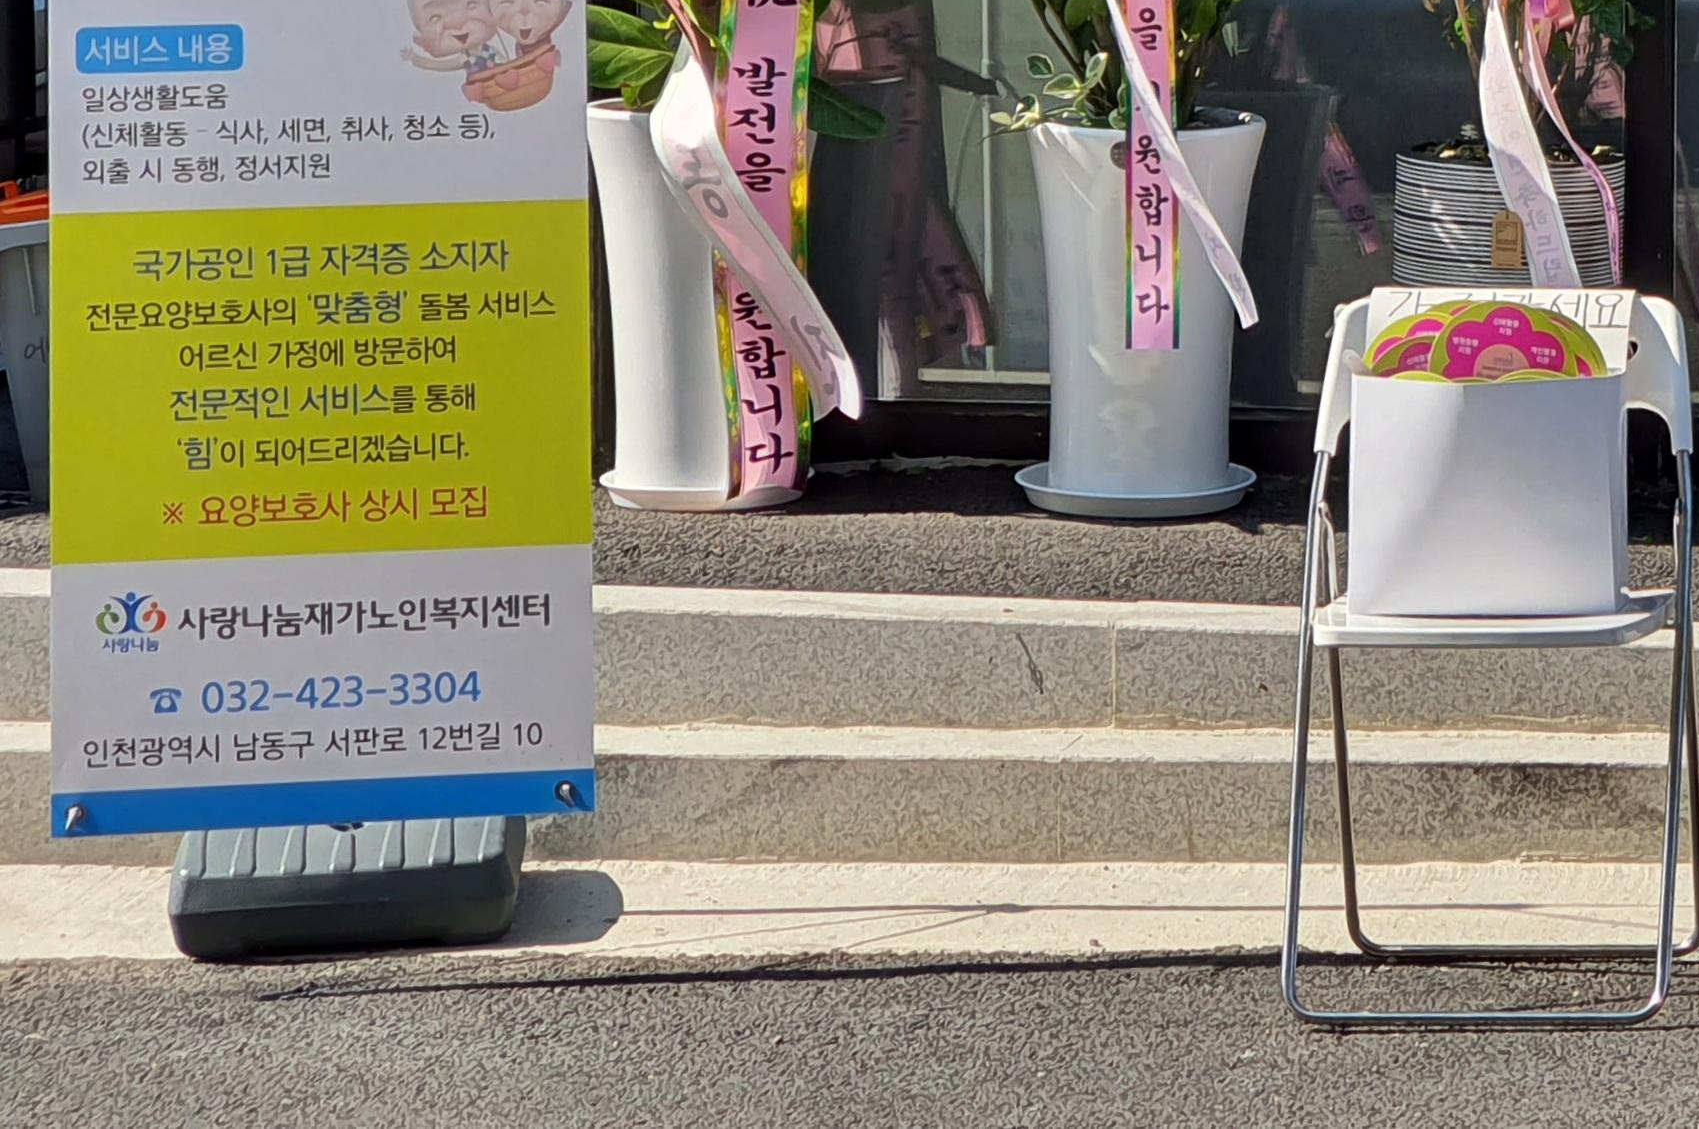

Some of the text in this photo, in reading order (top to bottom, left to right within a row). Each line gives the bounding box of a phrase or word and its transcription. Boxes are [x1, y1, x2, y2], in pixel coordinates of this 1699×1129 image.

[84, 33, 233, 66] 서비스 내용
[82, 83, 229, 113] 일상생활도움
[82, 113, 495, 150] (신체활동 식사, 세면, 취사, 청소 등),
[729, 58, 787, 193] 발전을
[82, 153, 331, 185] 외출 시 동행, 정서지원
[133, 239, 510, 282] 국가공인 1급 자격증 소지자
[86, 296, 296, 332] 전문요양보호사의
[418, 292, 471, 322] 돌봄
[477, 290, 556, 320] 서비스
[179, 335, 456, 372] 어르신 가정에 방문하여
[169, 382, 476, 422] 전문적인 서비스를 통해
[254, 431, 469, 467] 되어드리겠습니다.
[198, 485, 487, 528] 요양보호사 상시 모집
[178, 593, 550, 641] 사랑나눔재가노인복지센터
[102, 636, 160, 654] 사랑나눔
[201, 670, 482, 714] 032-423-3304
[83, 721, 543, 769] 인천광역시 남동구 서판로 12번길 10
